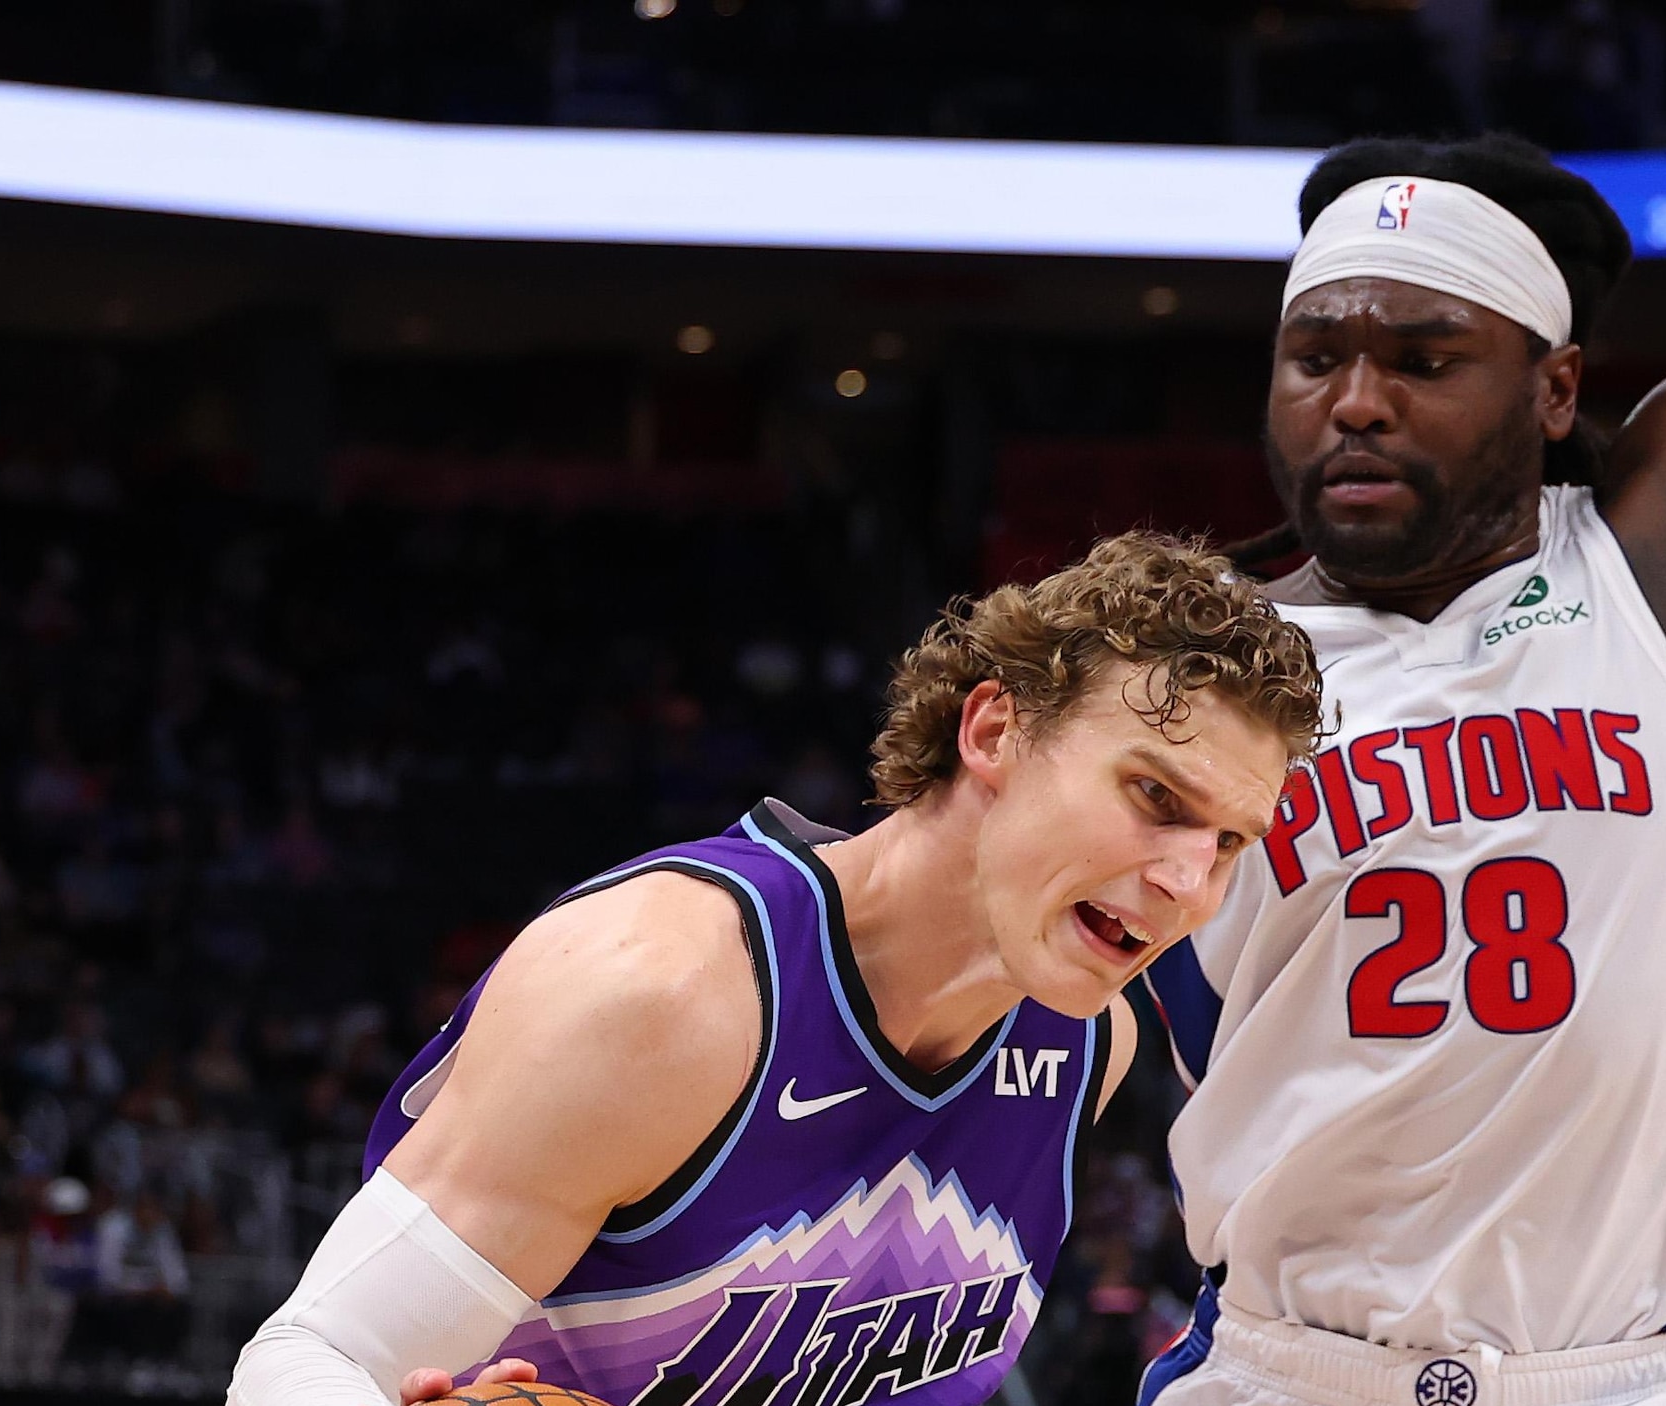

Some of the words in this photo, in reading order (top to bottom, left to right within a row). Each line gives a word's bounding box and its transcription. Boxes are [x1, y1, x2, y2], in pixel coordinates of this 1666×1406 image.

[1262, 707, 1652, 898] PISTONS
[1344, 855, 1576, 1038] 28
[994, 1047, 1069, 1098] LVT
